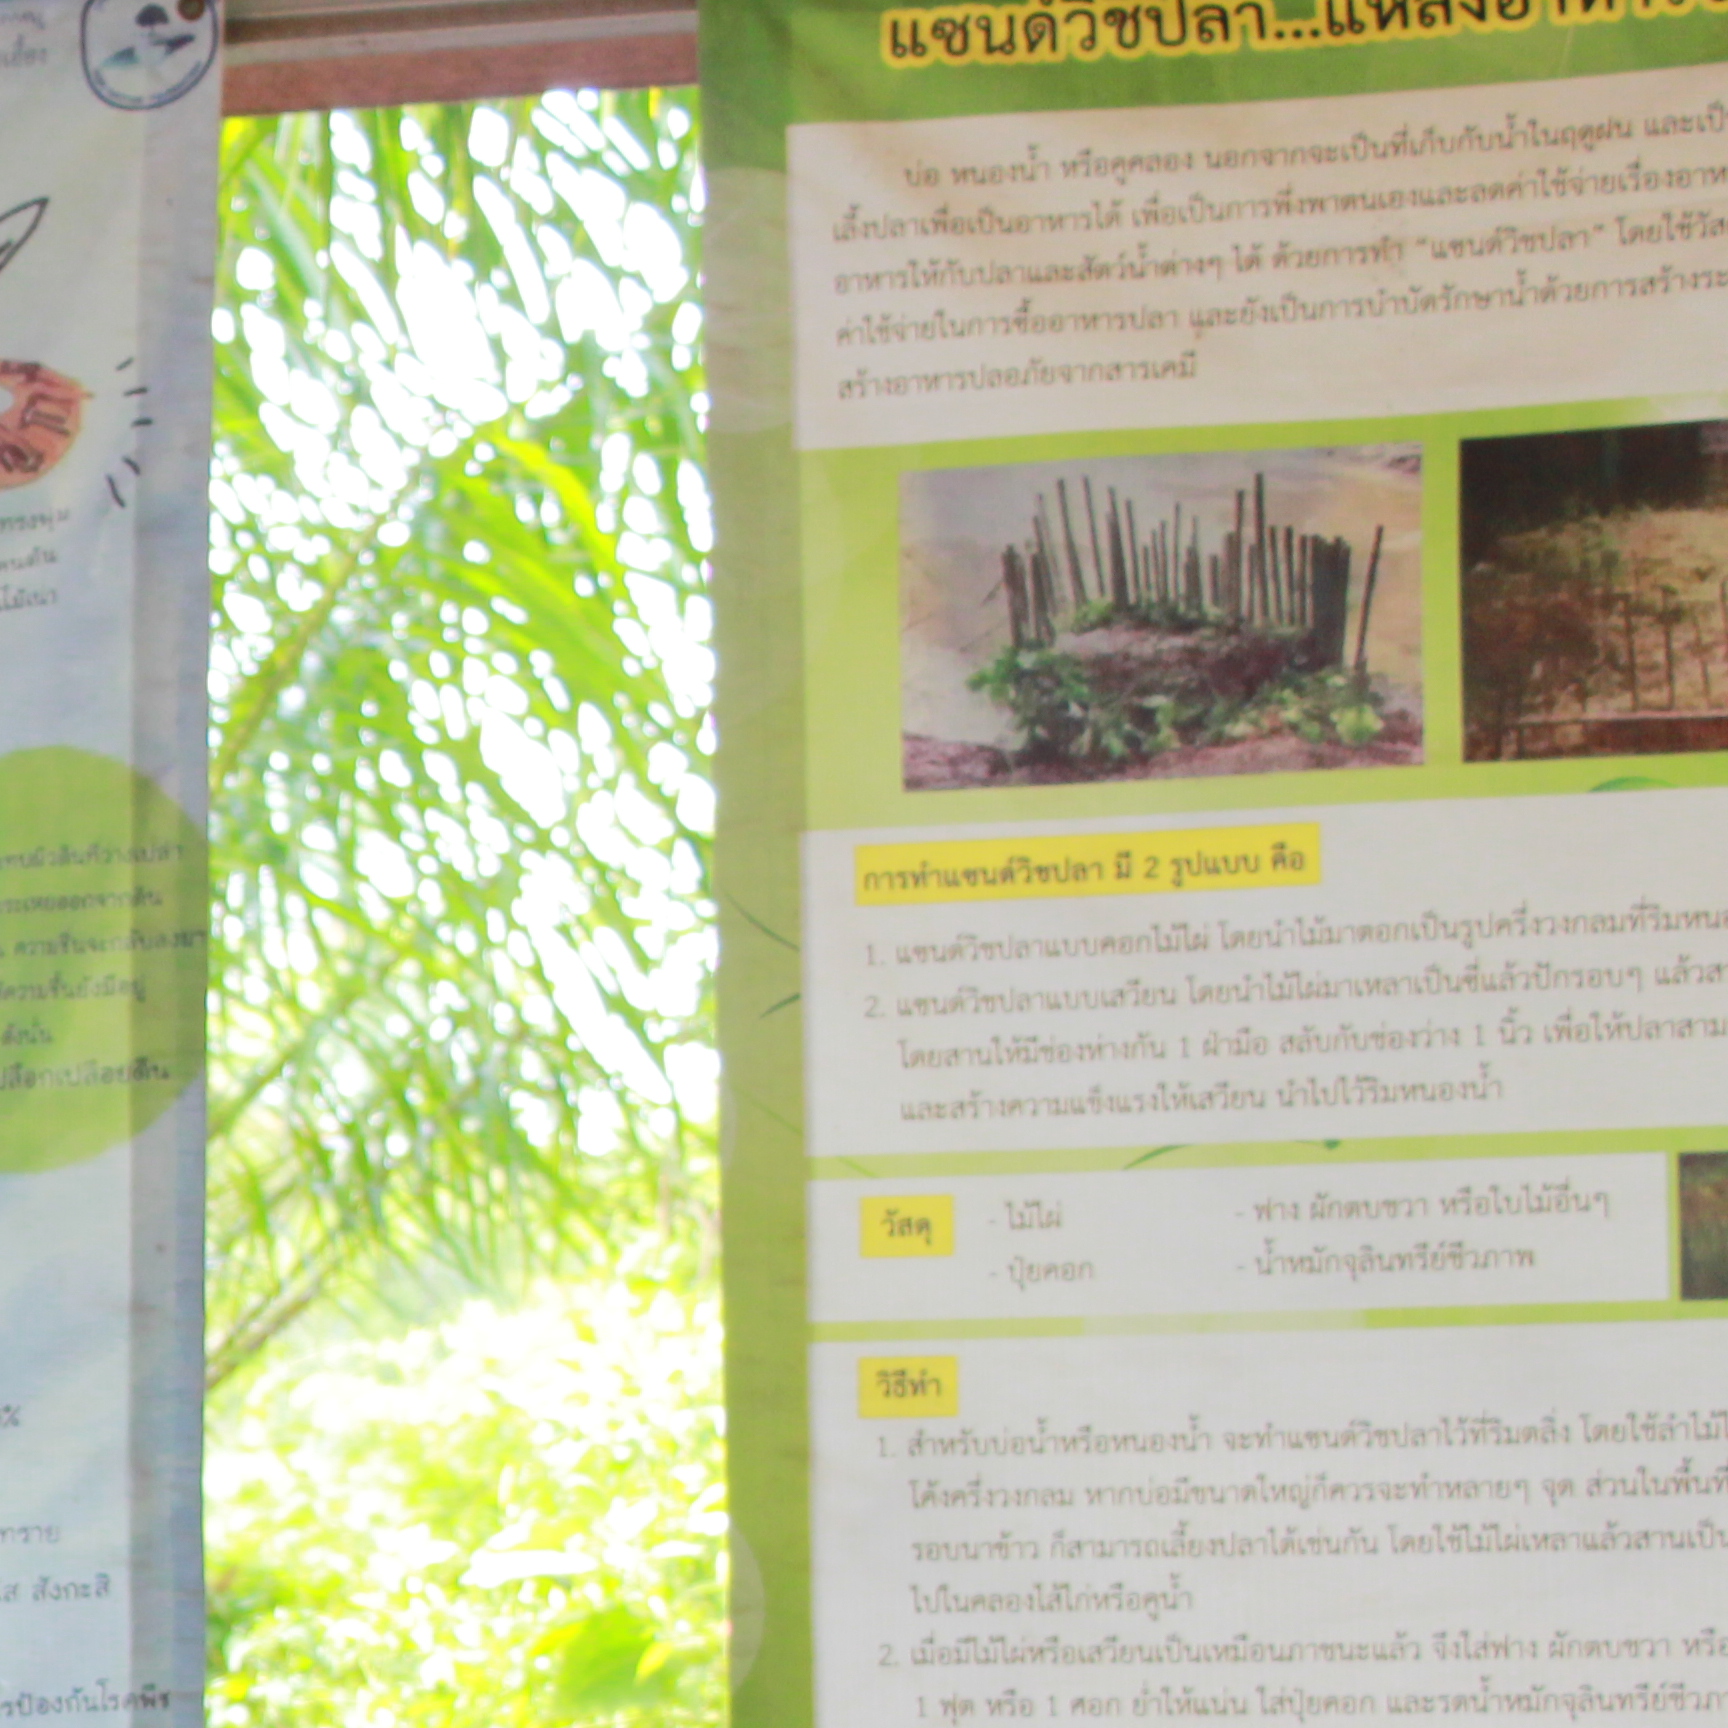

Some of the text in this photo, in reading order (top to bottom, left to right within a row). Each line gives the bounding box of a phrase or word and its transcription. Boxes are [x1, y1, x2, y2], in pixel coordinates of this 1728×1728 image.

[904, 159, 940, 188] บ่อ
[951, 143, 1050, 186] หนองน้ำ
[1645, 100, 1728, 136] และเป็
[1616, 210, 1728, 247] โดยใช้วัส
[1113, 850, 1133, 879] มี
[1144, 856, 1161, 879] 2
[1170, 852, 1261, 887] รูปแบบ
[1271, 841, 1306, 872] คือ
